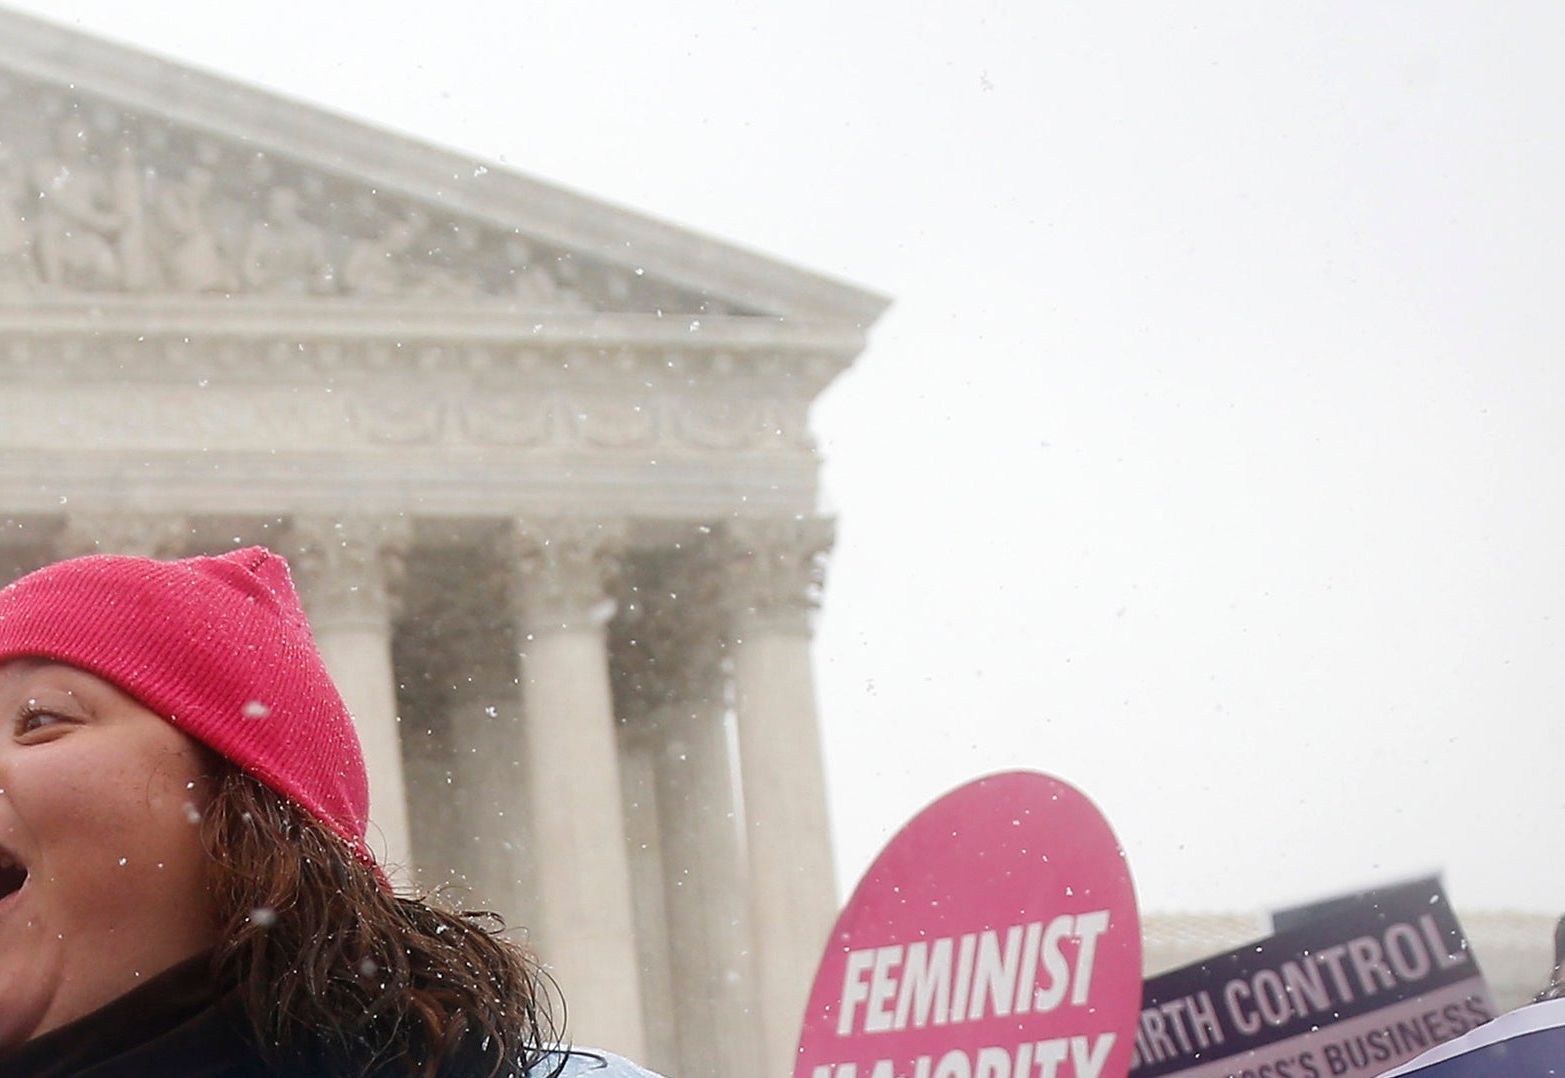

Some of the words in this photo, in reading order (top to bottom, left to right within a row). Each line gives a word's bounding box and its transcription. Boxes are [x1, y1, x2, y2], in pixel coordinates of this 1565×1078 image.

[838, 909, 1110, 1036] FEMINIST
[1132, 990, 1225, 1067] IRTH
[1224, 913, 1467, 1036] CONTROL
[1324, 995, 1491, 1076] BUSINESS
